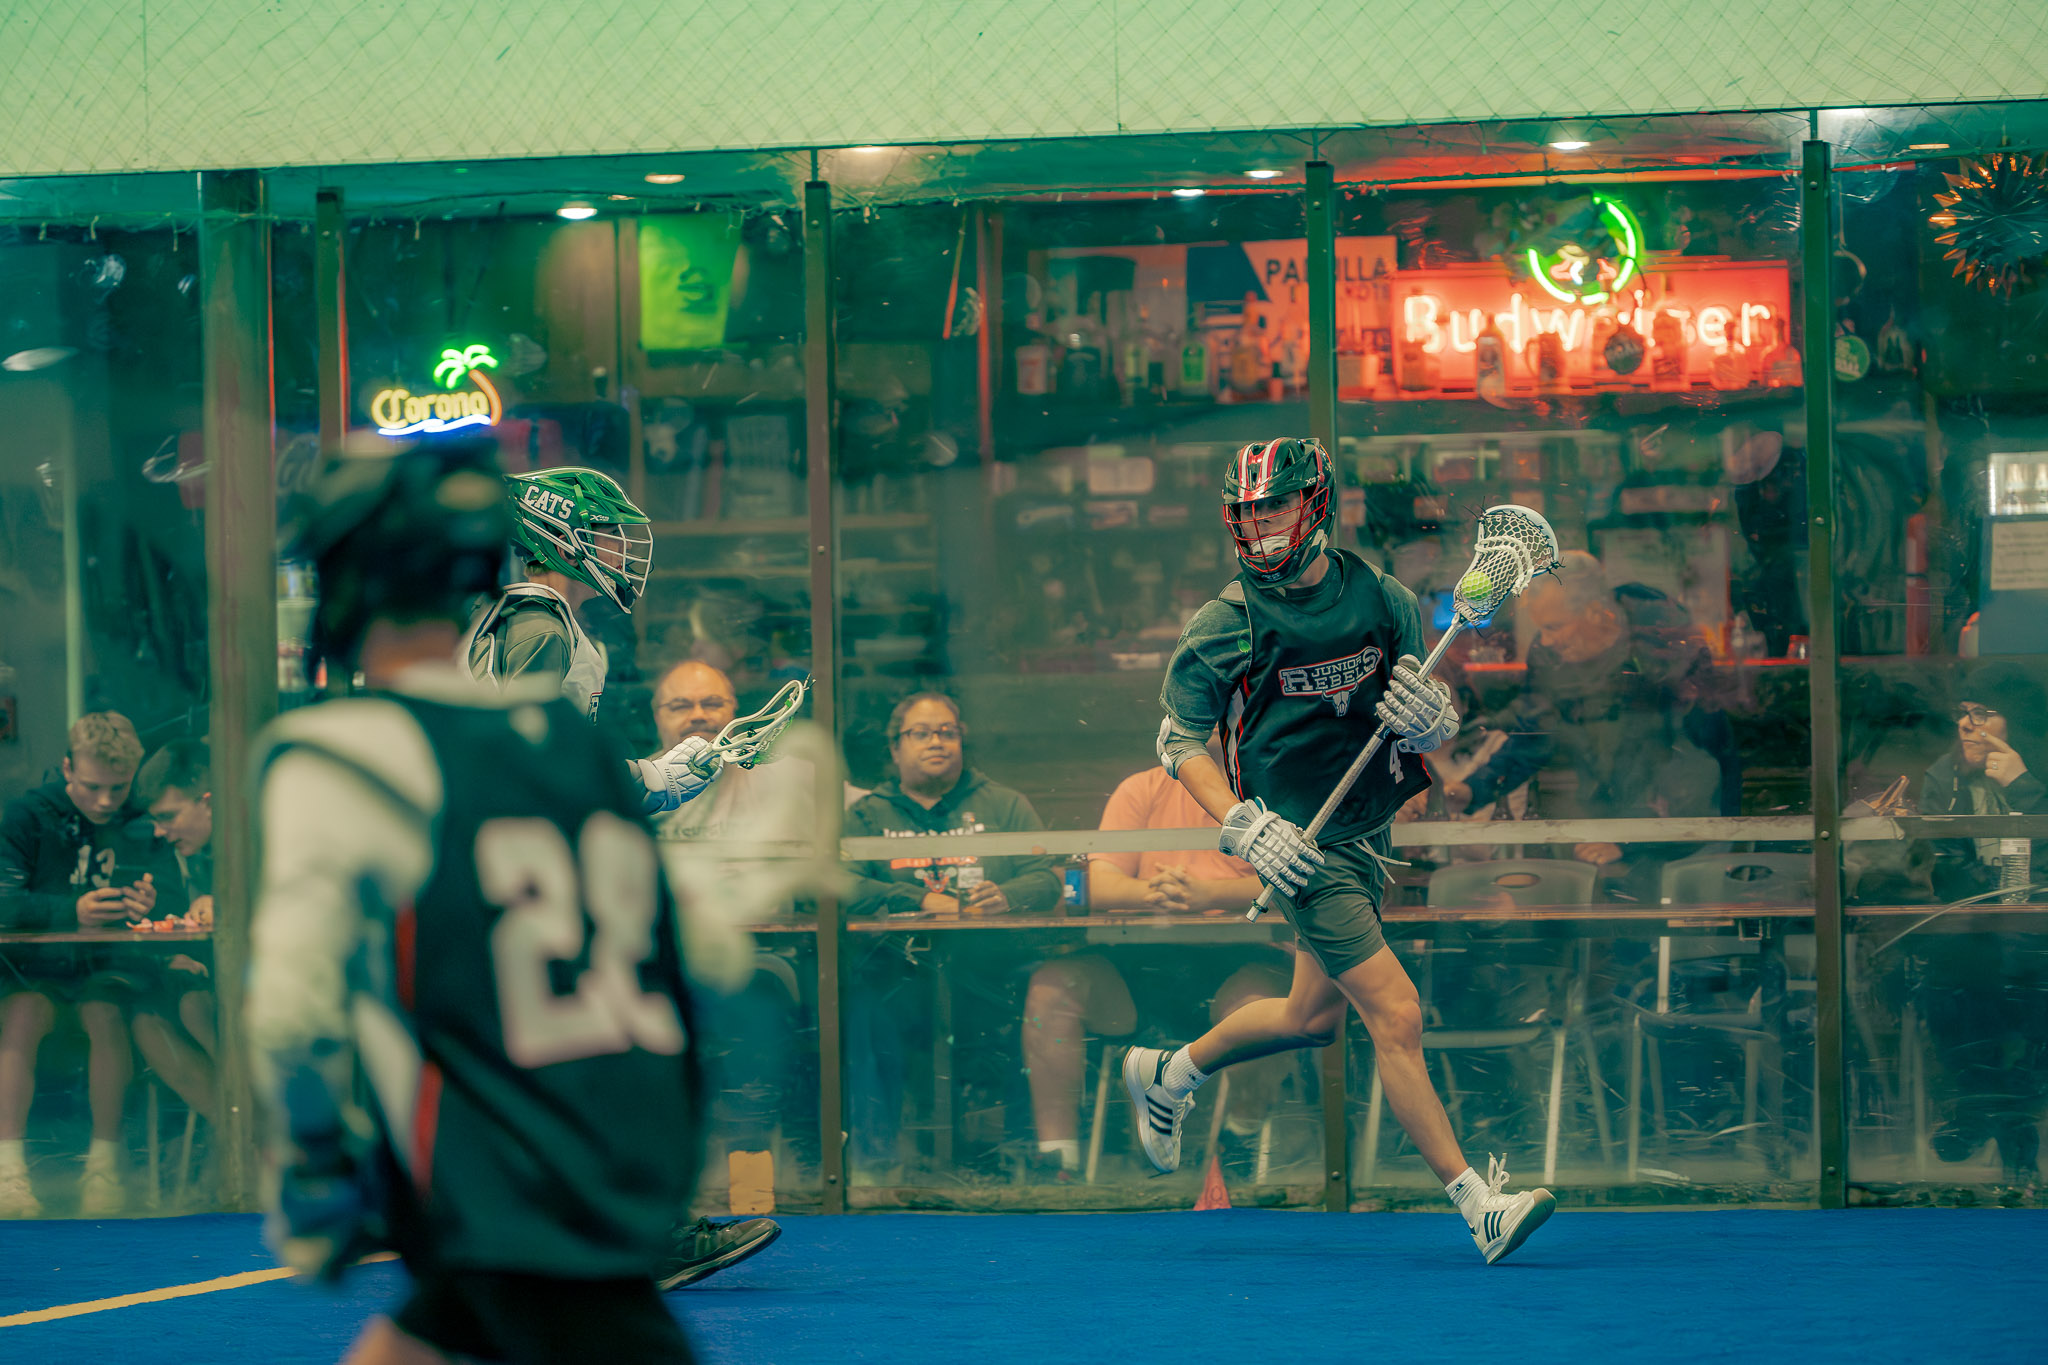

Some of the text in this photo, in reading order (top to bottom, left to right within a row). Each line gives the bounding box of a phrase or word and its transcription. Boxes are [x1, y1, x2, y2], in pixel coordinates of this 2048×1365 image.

[371, 388, 489, 429] Corona
[524, 485, 575, 519] CATS
[1282, 649, 1377, 691] REBELS
[1389, 739, 1405, 785] 4
